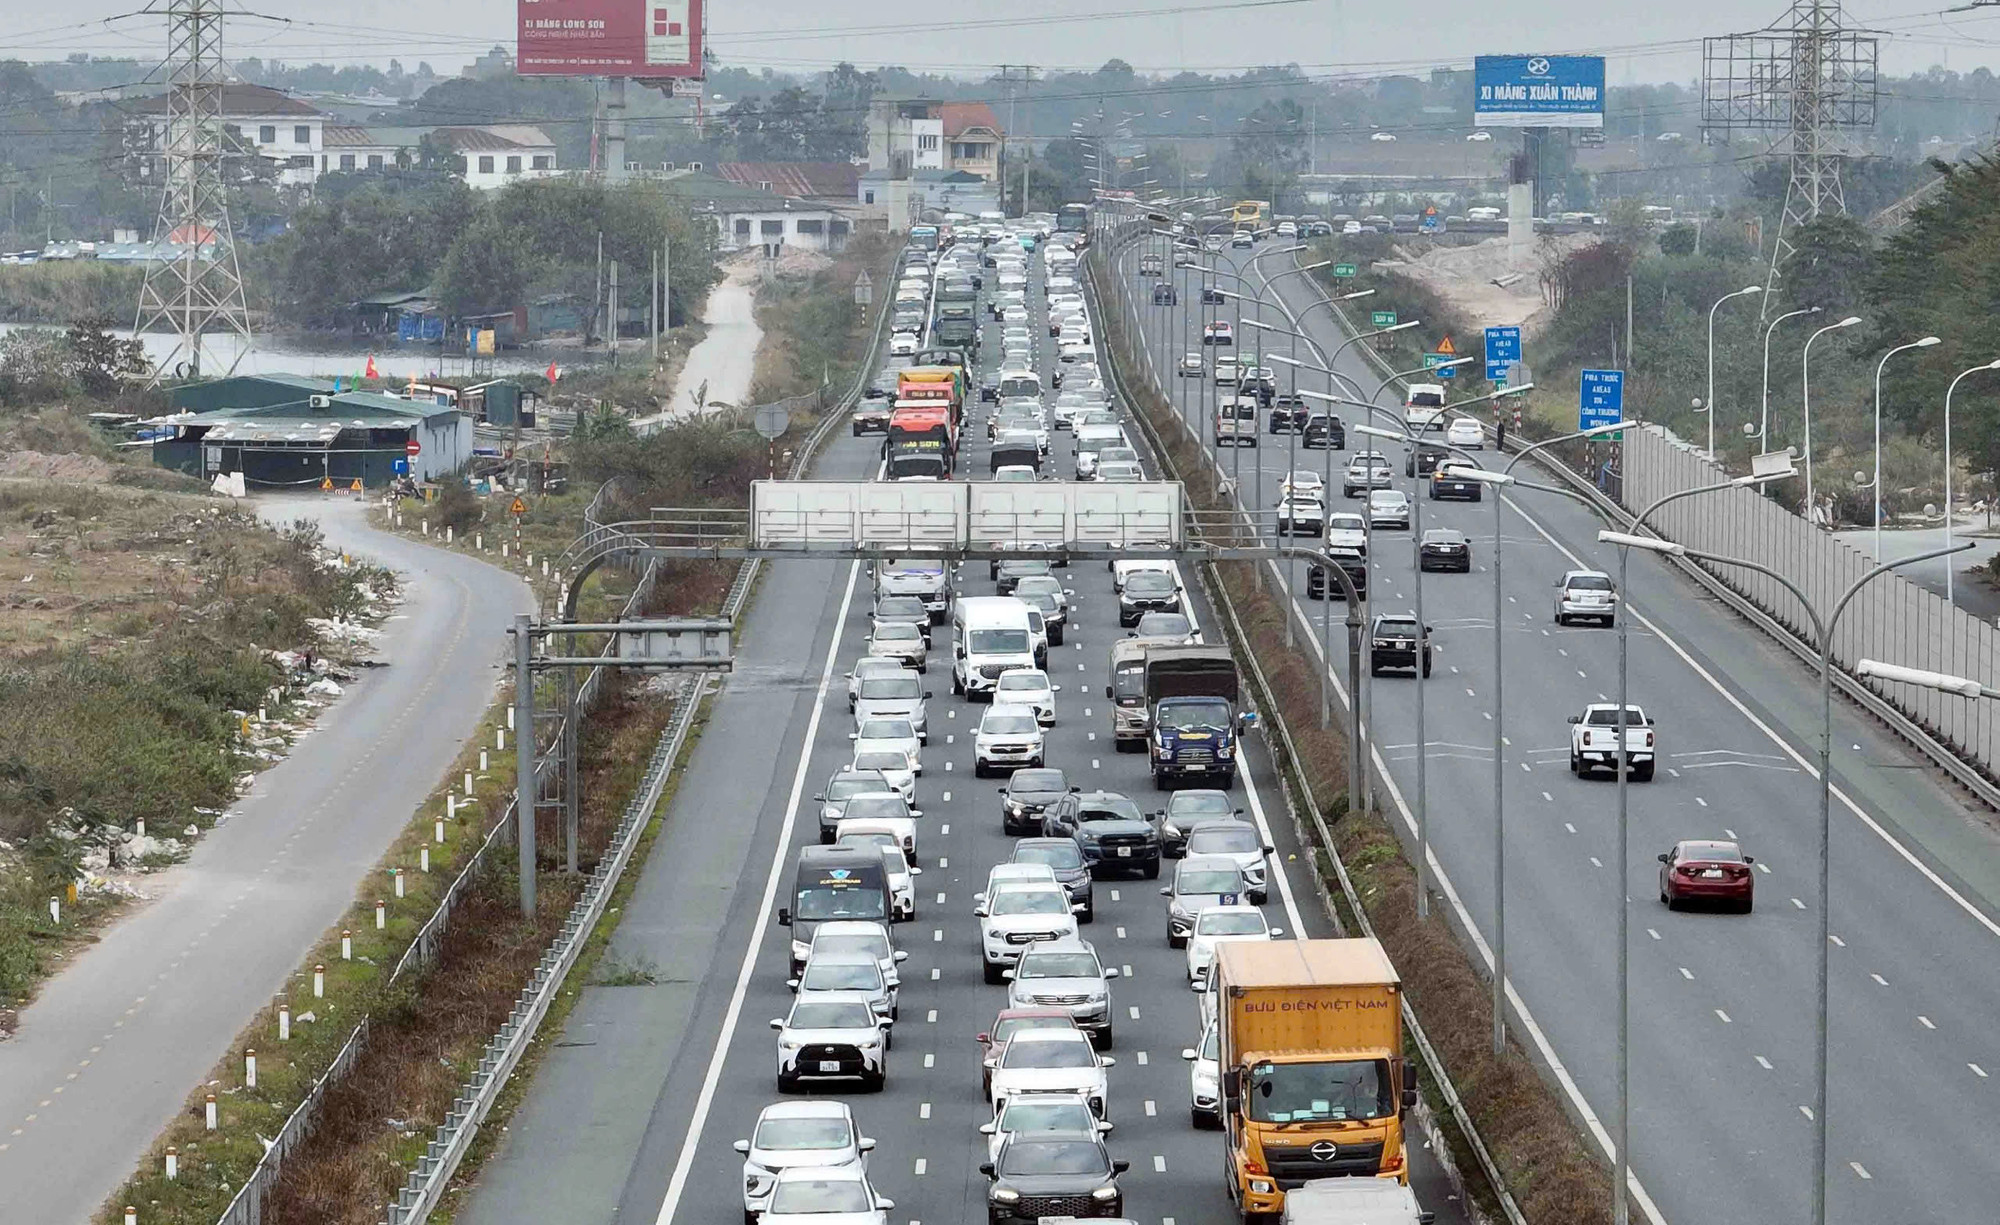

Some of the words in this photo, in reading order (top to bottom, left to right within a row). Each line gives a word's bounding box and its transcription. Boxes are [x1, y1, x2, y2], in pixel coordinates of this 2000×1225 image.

[525, 20, 533, 28] XI
[563, 20, 585, 28] LONG
[1481, 86, 1492, 100] XI
[1495, 82, 1526, 100] MĂNG
[1529, 83, 1558, 100] XUÂN
[1561, 82, 1597, 101] THÀNH
[1245, 1001, 1276, 1013] BƯU
[1281, 1000, 1319, 1014] ĐIỆN
[1320, 998, 1352, 1013] VIỆT
[1355, 999, 1388, 1010] NAM
